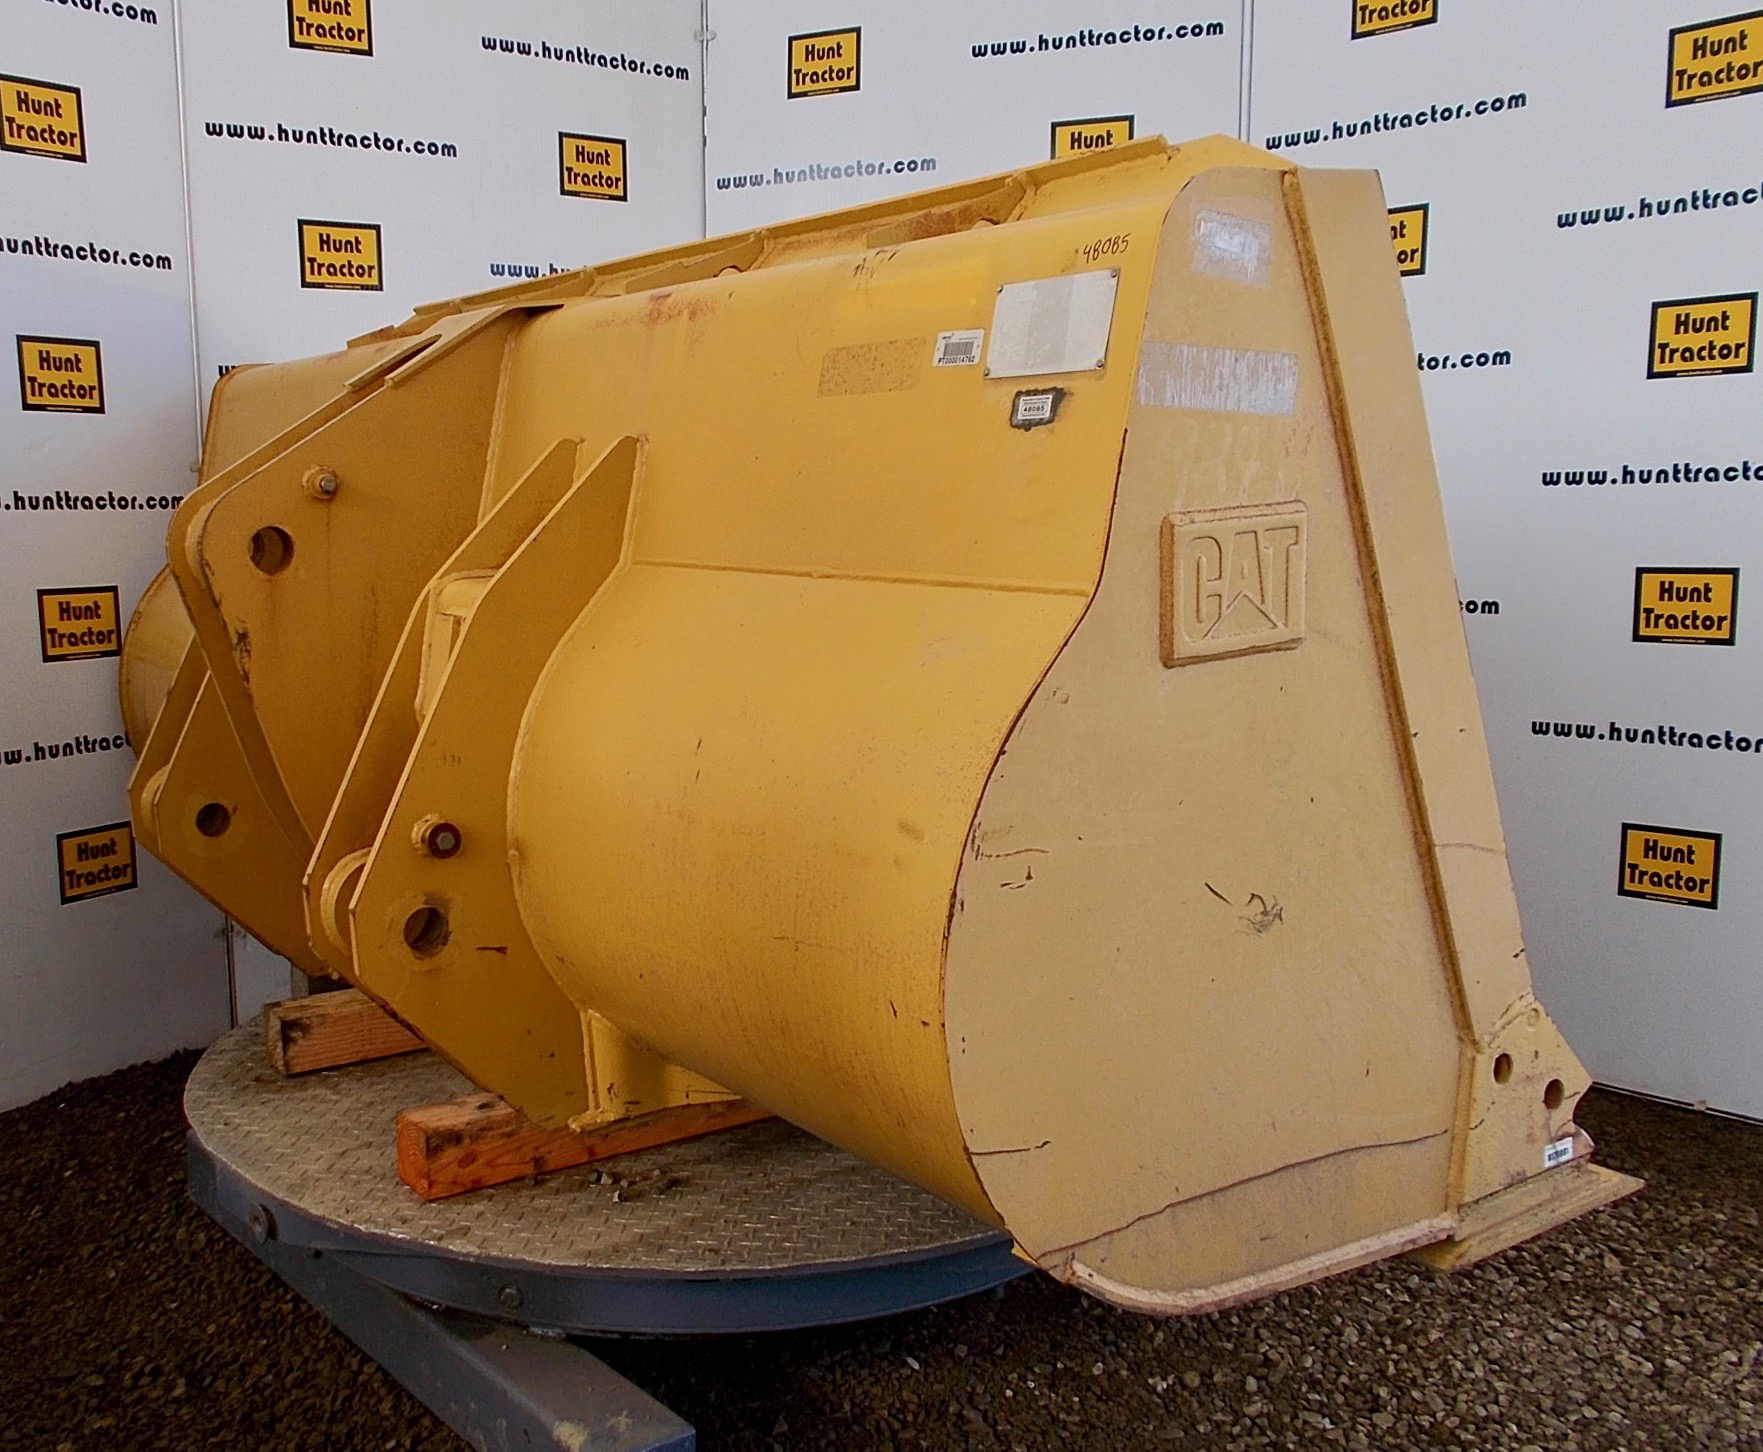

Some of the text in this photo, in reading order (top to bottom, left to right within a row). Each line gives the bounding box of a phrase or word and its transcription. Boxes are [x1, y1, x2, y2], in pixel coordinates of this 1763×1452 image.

[307, 0, 351, 16] Hunt
[1359, 0, 1429, 25] Tractor
[296, 16, 365, 42] Tractor
[972, 23, 1223, 57] www.hunttractor.com
[805, 42, 842, 62] Hunt
[1692, 30, 1748, 60] Hunt
[482, 37, 688, 80] www.hunttractor.com
[794, 64, 854, 86] Tractor
[1676, 60, 1763, 91] Tractor
[16, 90, 62, 118] Hunt
[5, 115, 78, 147] Tractor
[1266, 93, 1526, 150] www.hunttractor.com
[206, 123, 456, 157] www.hunttractor.com
[1070, 130, 1113, 150] Hunt
[575, 145, 611, 166] Hunt
[565, 167, 621, 189] Tractor
[717, 156, 937, 190] www.hunttractor.com
[319, 233, 361, 254] Hunt
[1083, 232, 1131, 263] 48085
[307, 257, 375, 278] Tractor
[1675, 310, 1730, 335] Hunt
[39, 350, 82, 373] Hunt
[1658, 340, 1745, 364] Tractor
[28, 376, 97, 399] Tractor
[1182, 526, 1298, 643] CAT
[1659, 581, 1712, 603] Hunt
[59, 601, 101, 621] Hunt
[1643, 608, 1728, 631] Tractor
[48, 627, 114, 648] Tractor
[77, 838, 117, 862] Hunt
[1643, 838, 1695, 865] Hunt
[66, 863, 130, 888] Tractor
[1628, 864, 1710, 894] Tractor
